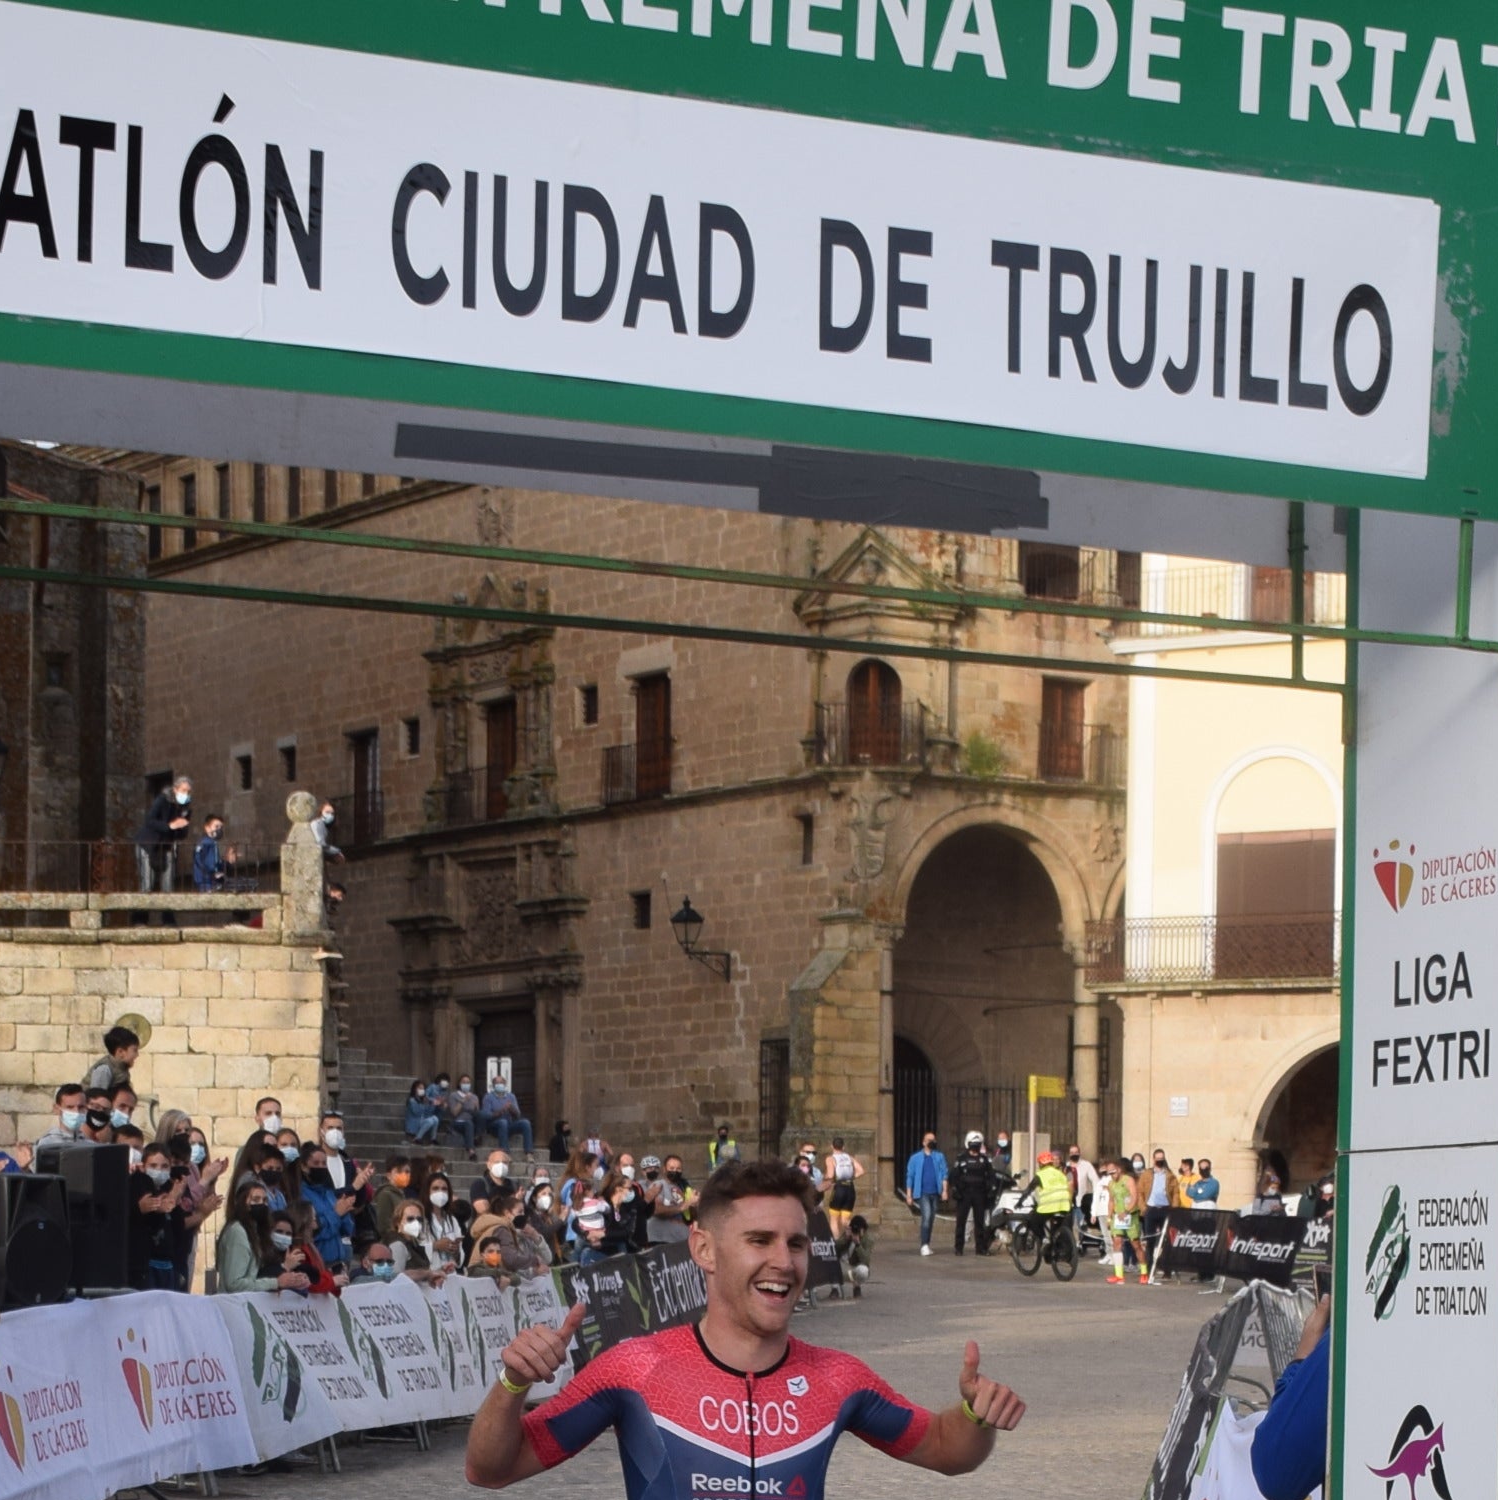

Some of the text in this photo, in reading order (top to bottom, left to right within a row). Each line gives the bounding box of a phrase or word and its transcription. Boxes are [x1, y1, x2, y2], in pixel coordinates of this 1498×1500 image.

[1047, 0, 1182, 104] DE
[391, 162, 755, 339] CIUDAD
[819, 217, 934, 364] DE
[991, 239, 1393, 417] TRUJILLO
[1421, 847, 1497, 881] DIPUTACIÓN
[1421, 875, 1497, 906] DE CÁCERES
[1393, 950, 1473, 1008] LIGA
[1372, 1028, 1491, 1088] FEXTRI
[1417, 1190, 1489, 1228] FEDERACIÓN
[1419, 1237, 1485, 1272] EXTREMEÑA
[1415, 1286, 1487, 1316] DE TRIATLON
[22, 1375, 83, 1423] DIPUTACIÓN
[158, 1398, 175, 1425] DE
[698, 1394, 800, 1437] COBOS
[691, 1472, 783, 1496] Reebok
